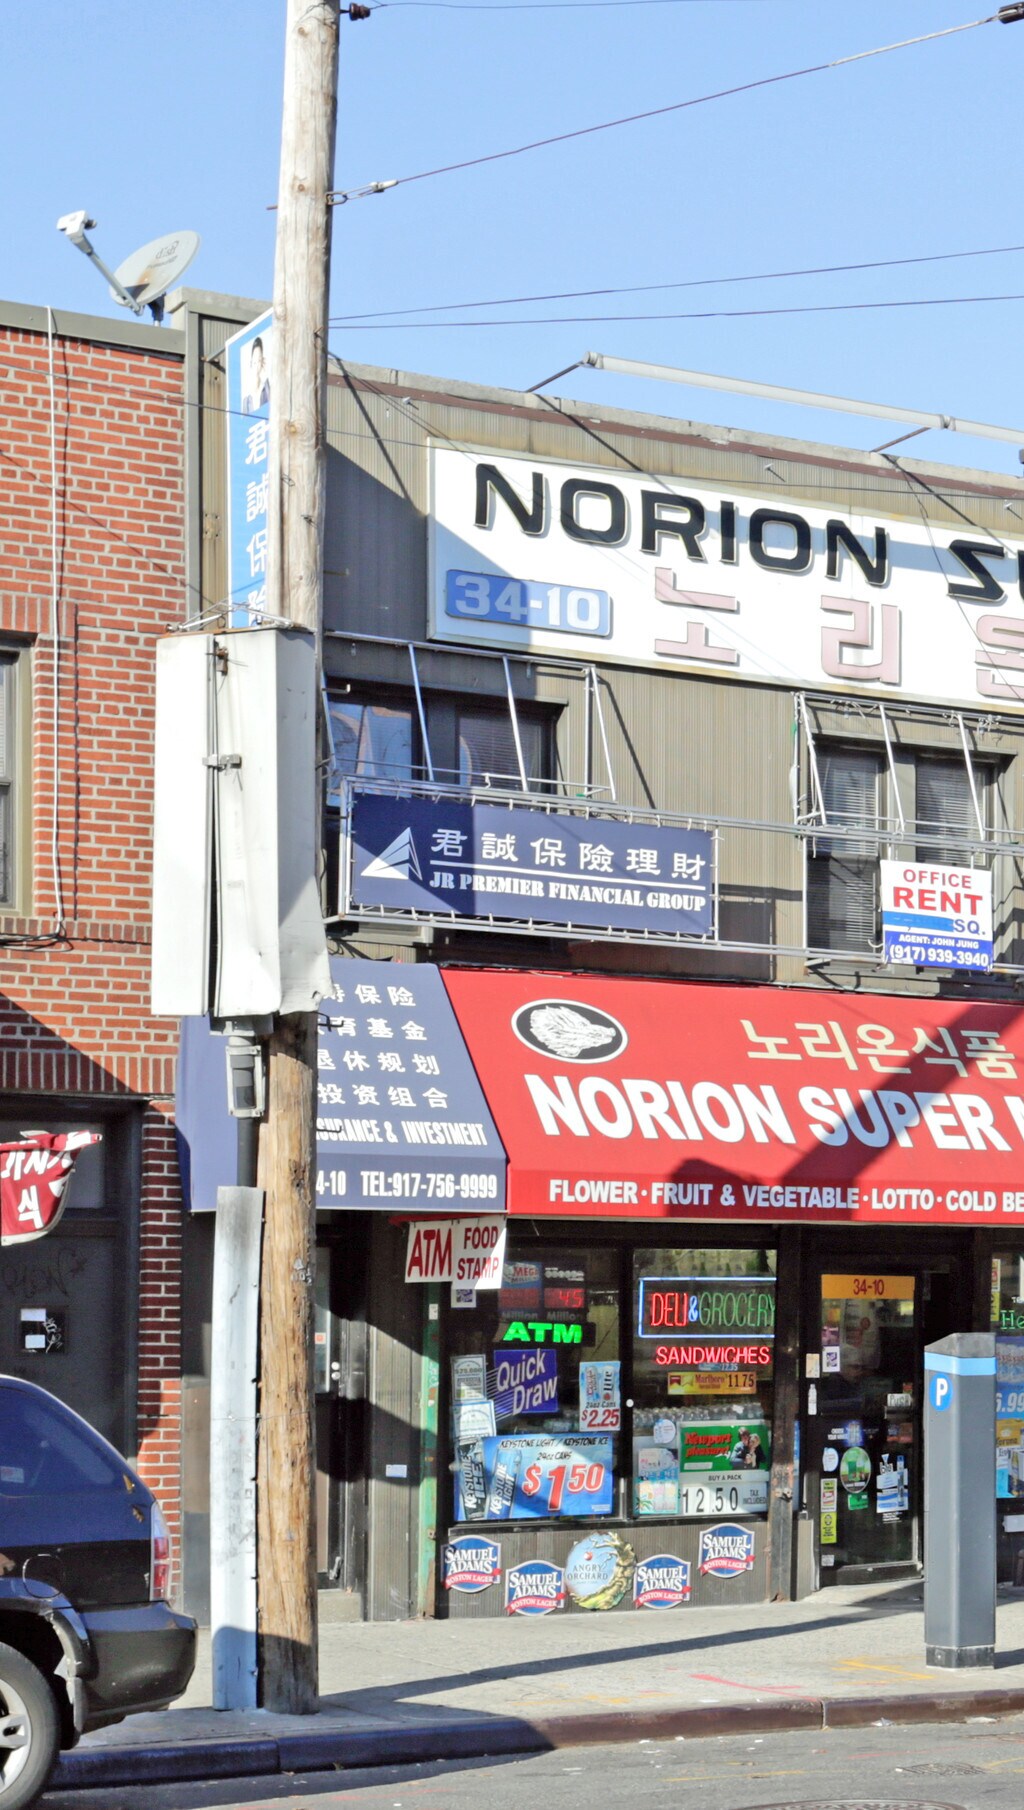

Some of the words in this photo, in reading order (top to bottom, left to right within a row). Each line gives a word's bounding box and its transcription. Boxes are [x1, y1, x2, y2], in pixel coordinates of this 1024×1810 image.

[474, 462, 889, 586] NORION
[454, 573, 603, 631] 34-10
[430, 828, 706, 881] 君誠保險理財
[903, 868, 972, 889] OFFICE
[430, 871, 455, 890] JR
[460, 874, 545, 898] PREMIER
[548, 882, 644, 908] FINANCIAL
[646, 891, 706, 912] GROUP
[893, 886, 983, 916] RENT
[953, 918, 986, 936] SQ.
[899, 934, 931, 944] AGENT:
[932, 937, 954, 947] JOHN
[956, 939, 979, 949] JUNG
[889, 944, 926, 962] (917)
[927, 947, 989, 967] 939-3940
[740, 1019, 1019, 1080] 노리온식품
[318, 1083, 449, 1109] 投资组合
[523, 1073, 797, 1144] NORION
[797, 1086, 1013, 1152] SUPER
[316, 1118, 384, 1144] SURANCE
[385, 1121, 399, 1144] &
[402, 1121, 488, 1146] INVESTMENT
[360, 1171, 498, 1199] TEL:917-756-9999
[549, 1179, 638, 1205] FLOWER
[651, 1182, 713, 1206] FRUIT
[719, 1184, 736, 1207] &
[743, 1184, 859, 1209] VEGETABLE
[871, 1187, 935, 1211] LOTTO
[945, 1190, 997, 1212] COLD
[463, 1226, 499, 1250] FOOD
[407, 1228, 452, 1278] ATM
[457, 1256, 500, 1280] STAMP
[853, 1278, 885, 1296] 34-10
[560, 1289, 584, 1309] 45
[651, 1292, 688, 1327] DELI
[689, 1295, 699, 1322] &
[700, 1291, 776, 1327] GROCERY
[502, 1321, 583, 1344] ATM
[655, 1346, 771, 1365] SANDWICHES
[496, 1347, 546, 1392] Quick
[512, 1376, 558, 1416] Draw
[936, 1378, 948, 1407] P
[581, 1408, 620, 1429] $2.25
[563, 1437, 596, 1446] KEYSTONE
[684, 1432, 732, 1447] Newport
[683, 1486, 739, 1514] 12.50
[702, 1534, 751, 1550] SAMUEL
[445, 1547, 498, 1564] SAMUEL
[705, 1547, 747, 1561] ADAMS
[447, 1560, 493, 1576] ADAMS
[567, 1572, 609, 1580] ORCHARD
[573, 1564, 601, 1572] ANGRY
[637, 1566, 687, 1582] SAMUEL
[509, 1572, 561, 1588] SAMUEL
[640, 1578, 683, 1594] ADAMS
[512, 1585, 557, 1601] ADAMS
